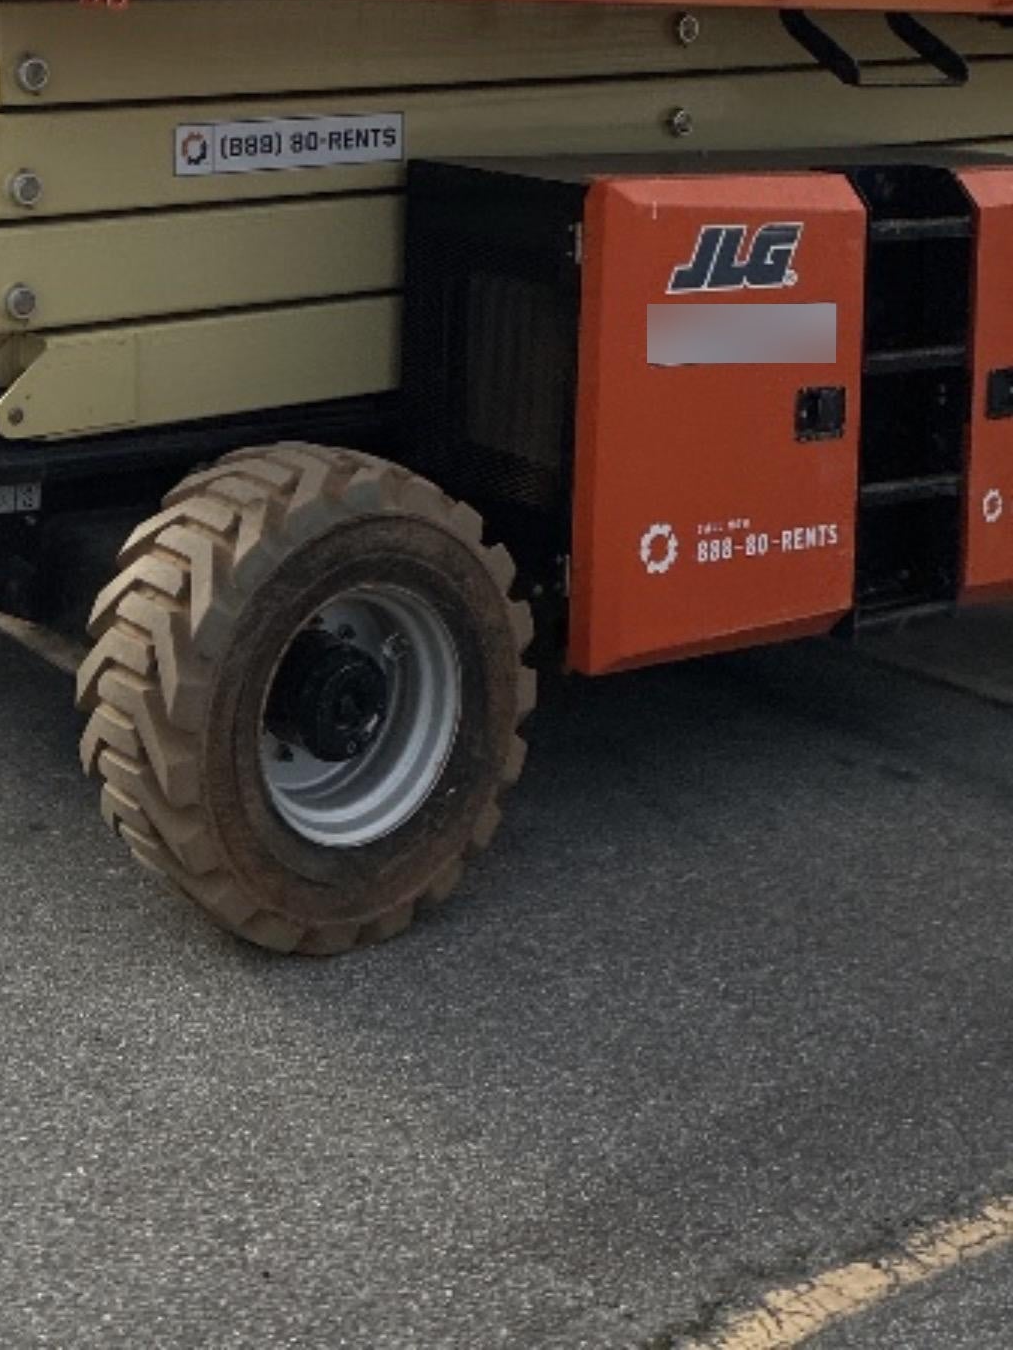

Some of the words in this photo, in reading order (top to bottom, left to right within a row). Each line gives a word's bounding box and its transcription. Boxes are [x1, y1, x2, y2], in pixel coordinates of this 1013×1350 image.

[289, 126, 397, 154] 80-RENTS
[665, 222, 804, 295] JLG
[697, 523, 838, 563] 888-80-RENTS
